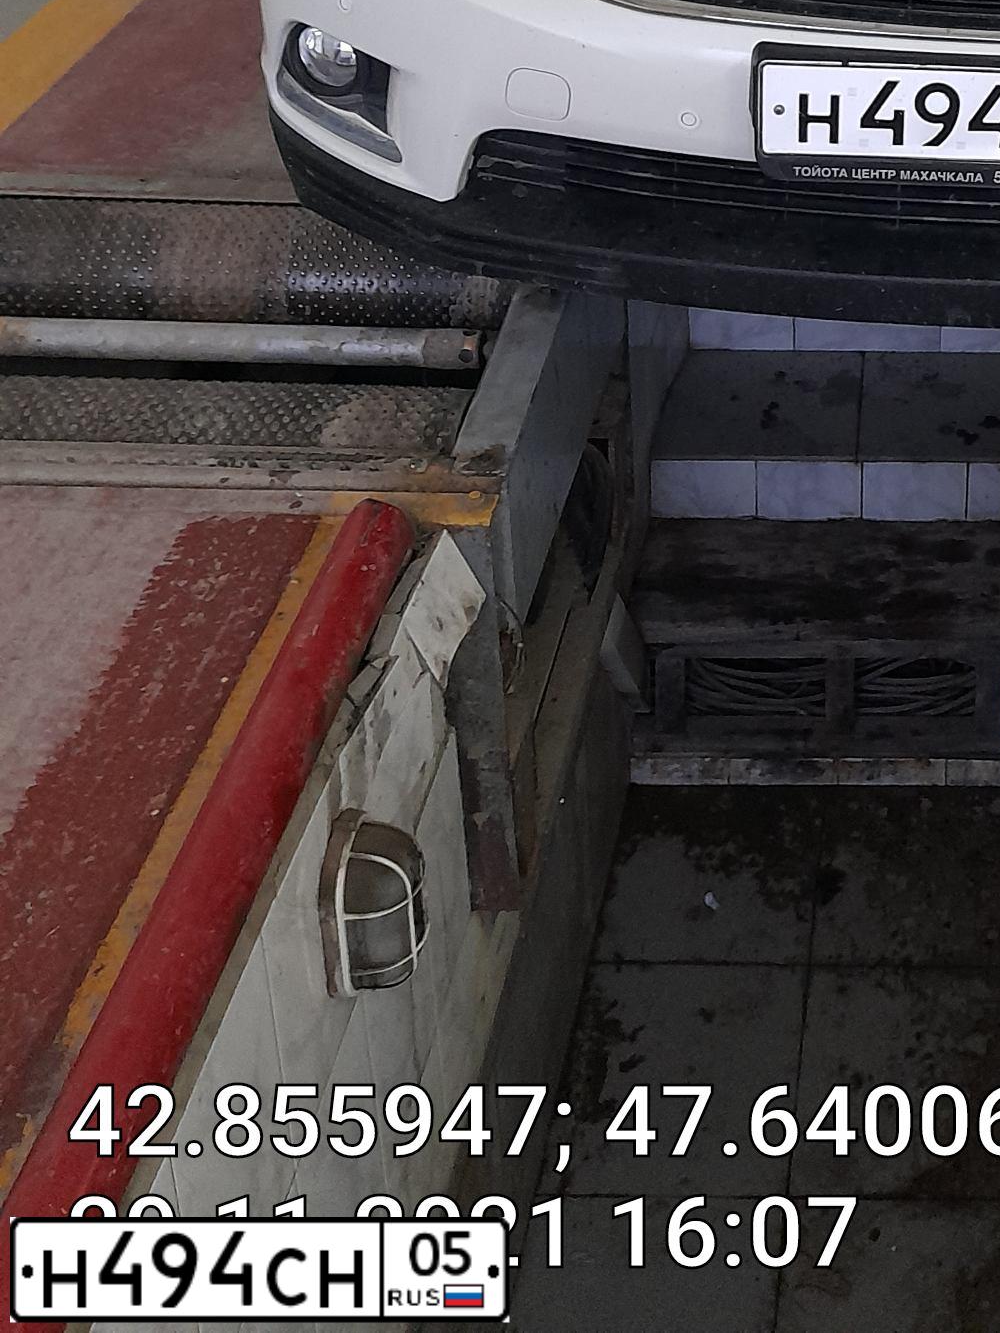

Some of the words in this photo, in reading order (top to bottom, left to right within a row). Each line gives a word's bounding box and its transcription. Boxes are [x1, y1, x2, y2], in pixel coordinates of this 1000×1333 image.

[792, 165, 848, 178] ТОЙОТА
[851, 168, 897, 180] ЦЕНТР
[900, 170, 984, 183] МАХАЧКАЛА
